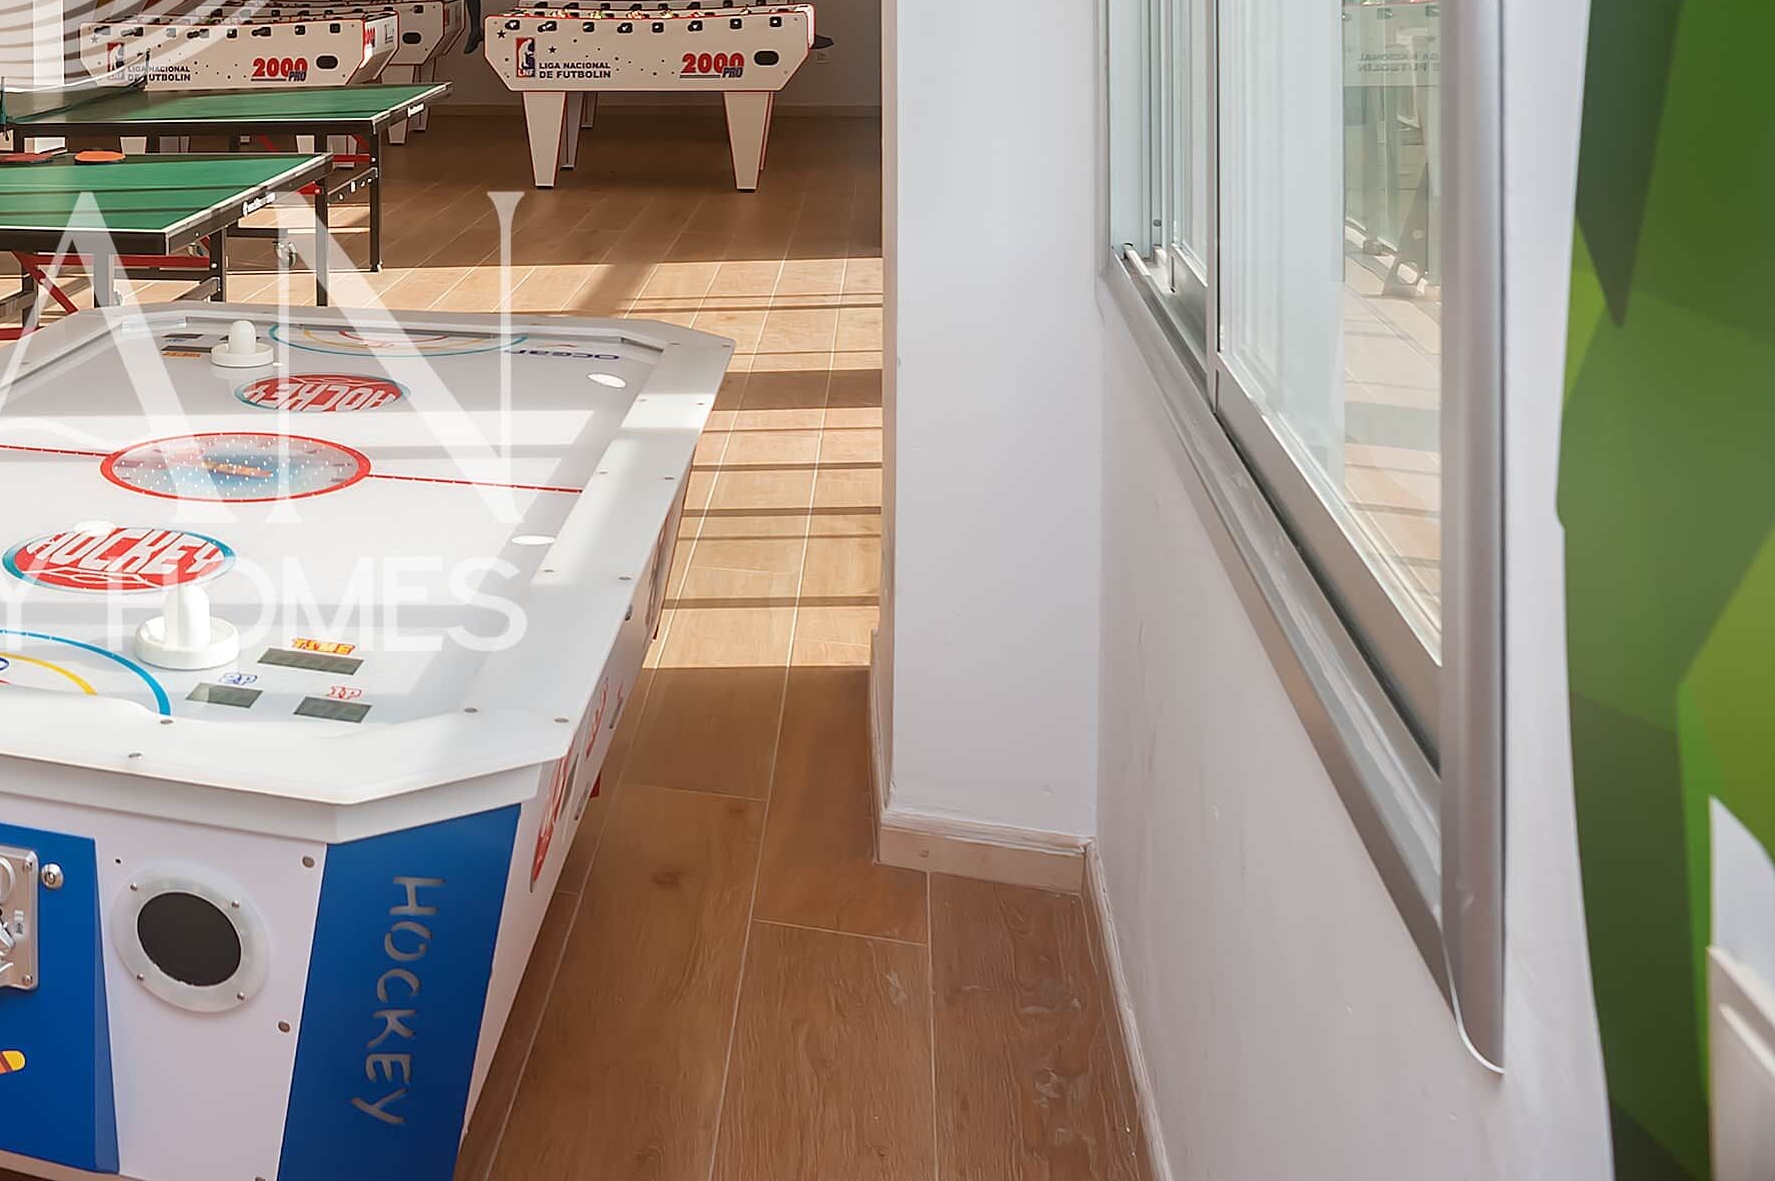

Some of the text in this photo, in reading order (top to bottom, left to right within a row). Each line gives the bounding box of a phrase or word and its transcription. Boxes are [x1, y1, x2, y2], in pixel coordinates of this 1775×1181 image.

[148, 65, 190, 73] NACIONAL
[252, 57, 308, 77] 2000
[680, 52, 745, 74] 2000
[147, 73, 191, 81] UTBOLIN
[288, 71, 307, 82] PRO
[539, 71, 553, 79] DE
[556, 71, 611, 79] FUTBOLIN
[722, 67, 743, 78] PRO
[243, 382, 396, 412] HOCKEY
[26, 528, 225, 575] HOCKEY
[293, 638, 355, 655] TIME
[351, 875, 446, 1124] HOCKEY
